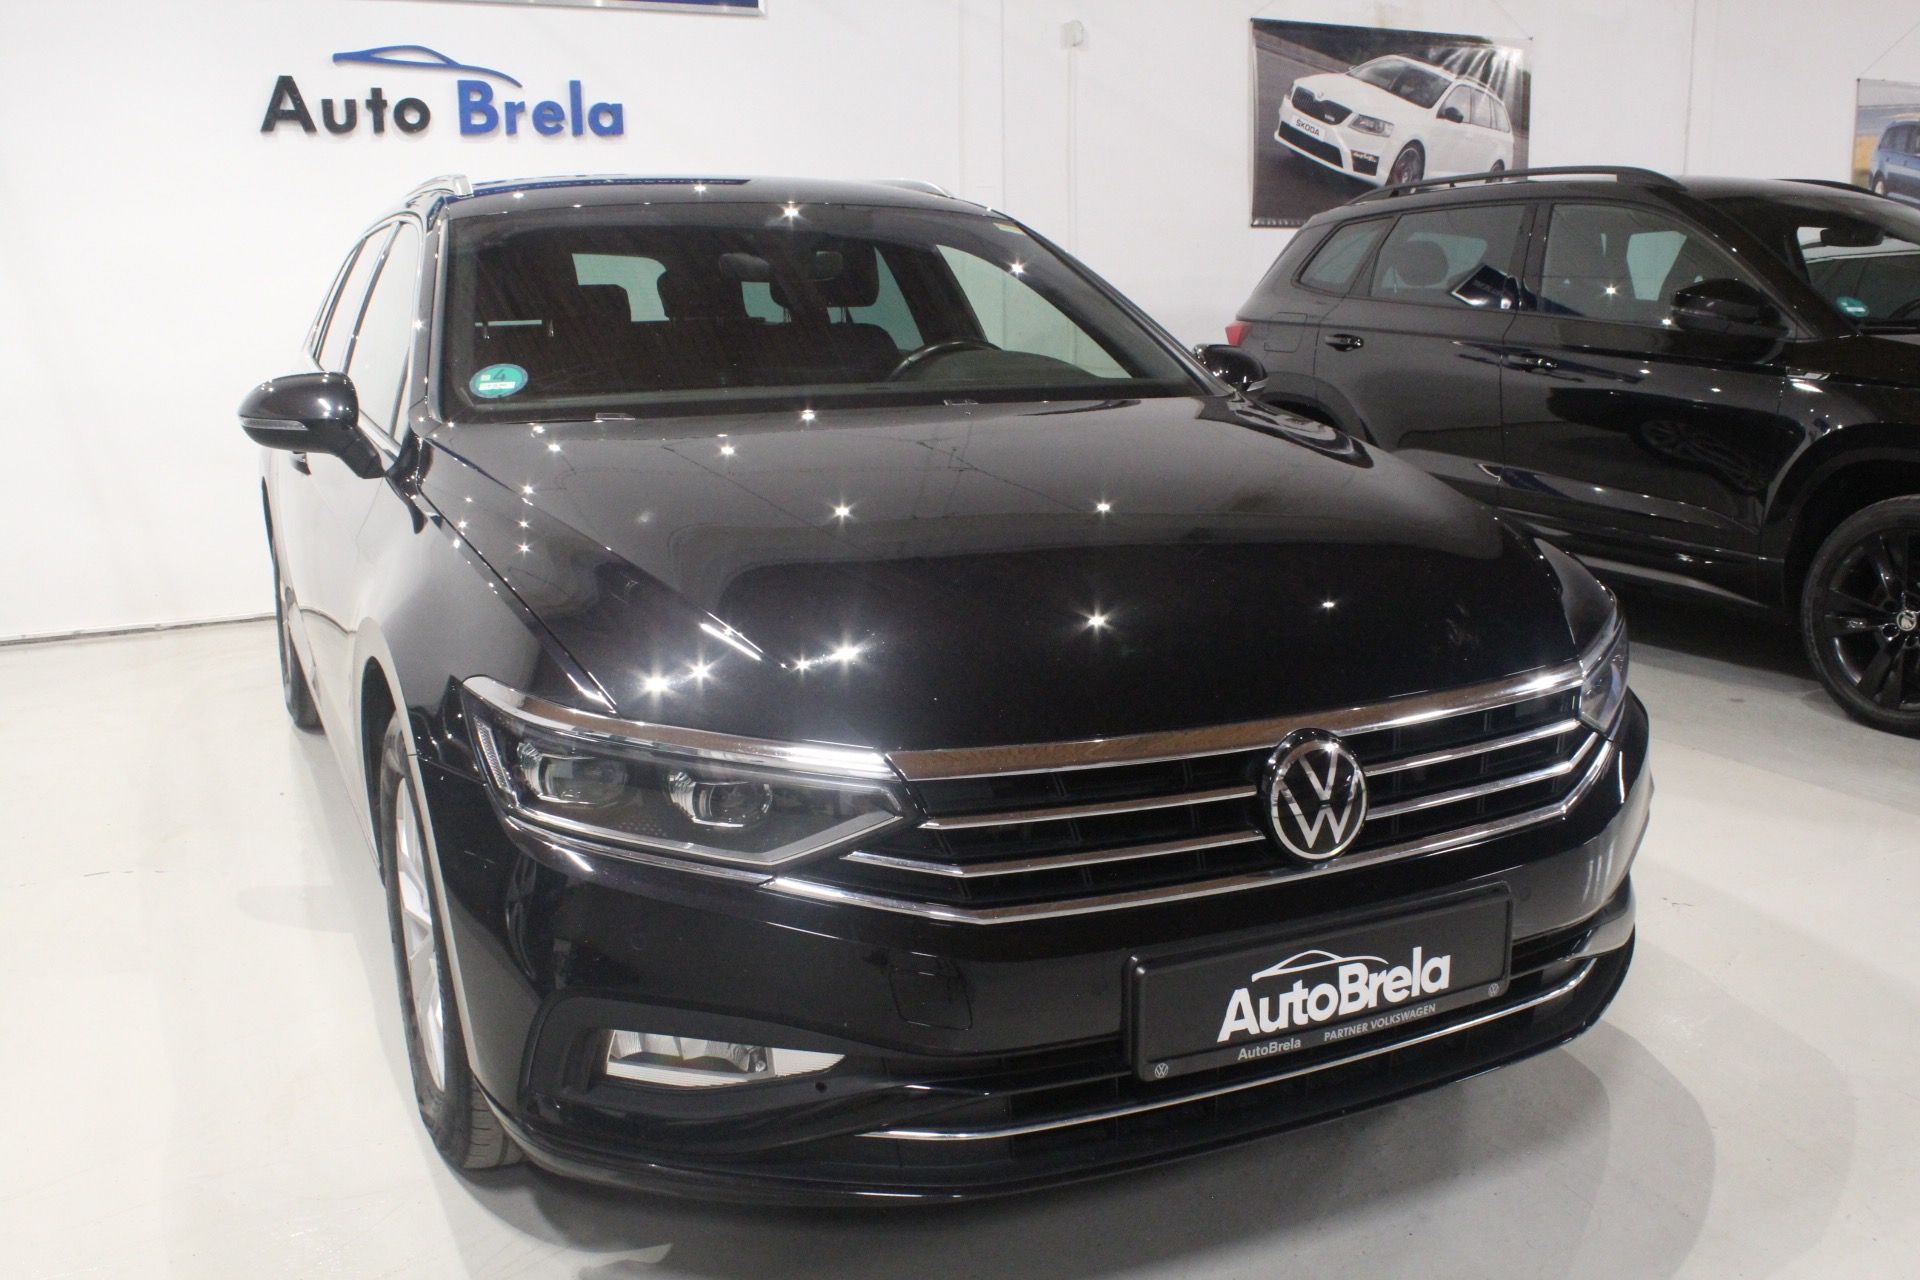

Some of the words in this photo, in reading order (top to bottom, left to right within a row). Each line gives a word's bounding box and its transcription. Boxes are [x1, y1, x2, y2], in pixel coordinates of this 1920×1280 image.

[260, 75, 431, 135] Auto
[457, 79, 624, 137] Brela
[493, 368, 506, 382] 4
[1217, 946, 1451, 1043] AutoBrela
[1323, 1022, 1369, 1042] PARTNER
[1370, 1002, 1437, 1031] VOLKSWAGEN
[1237, 1037, 1302, 1061] AutoBrela
